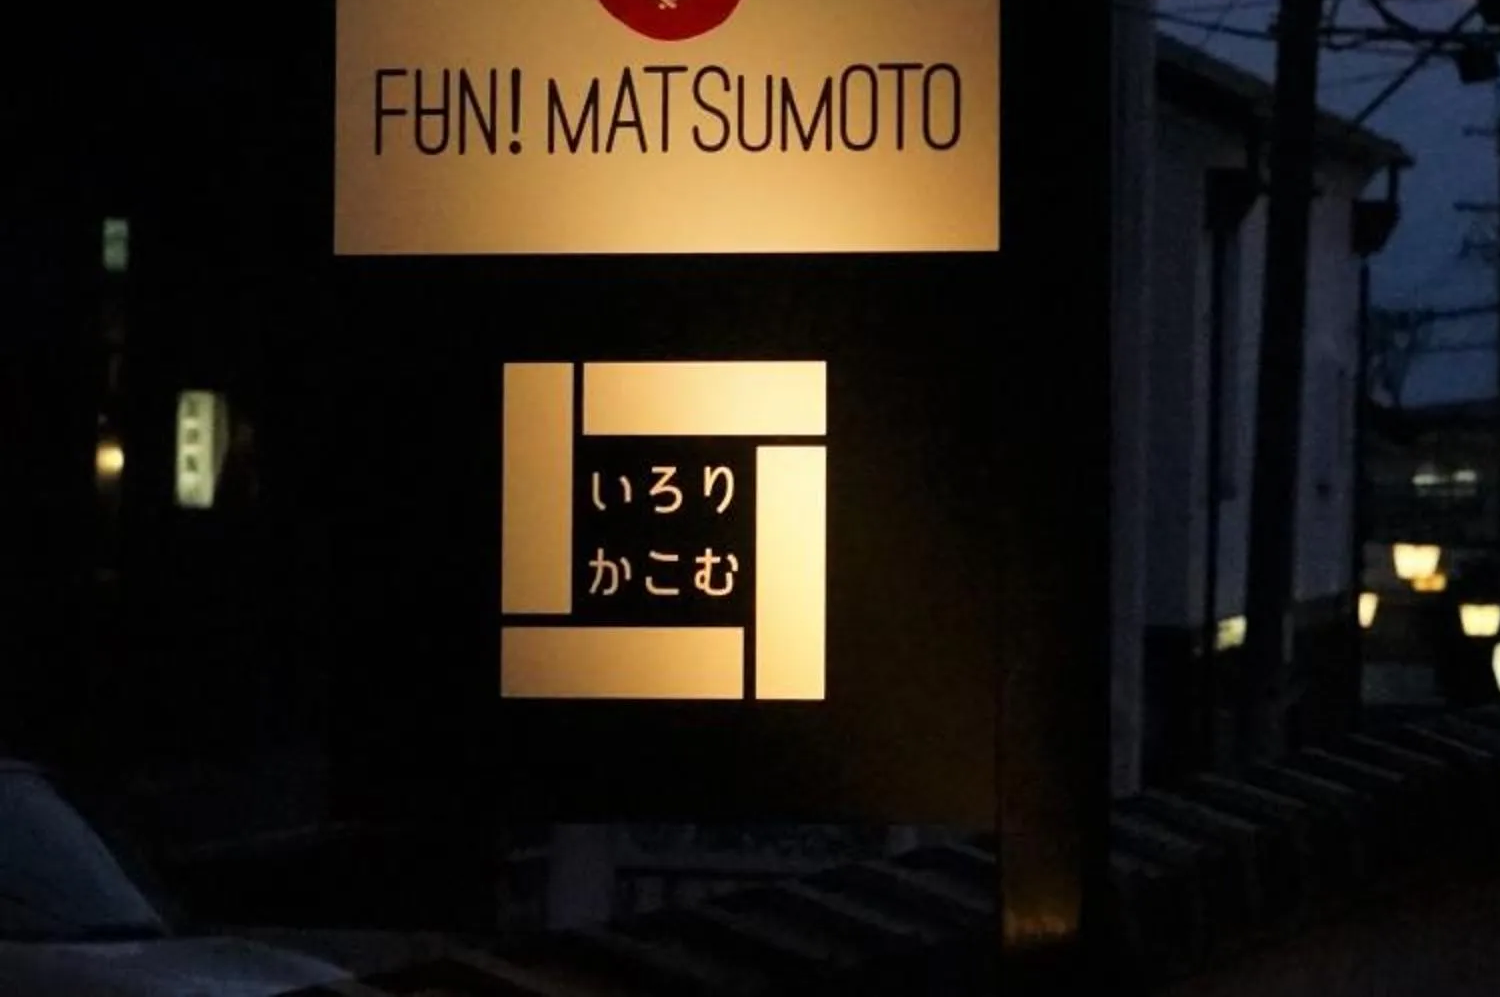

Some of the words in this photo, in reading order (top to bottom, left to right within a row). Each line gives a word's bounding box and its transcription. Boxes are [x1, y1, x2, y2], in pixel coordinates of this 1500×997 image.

[546, 62, 962, 154] MATSUMOTO
[591, 465, 735, 514] いろり
[588, 548, 739, 596] かこむ
